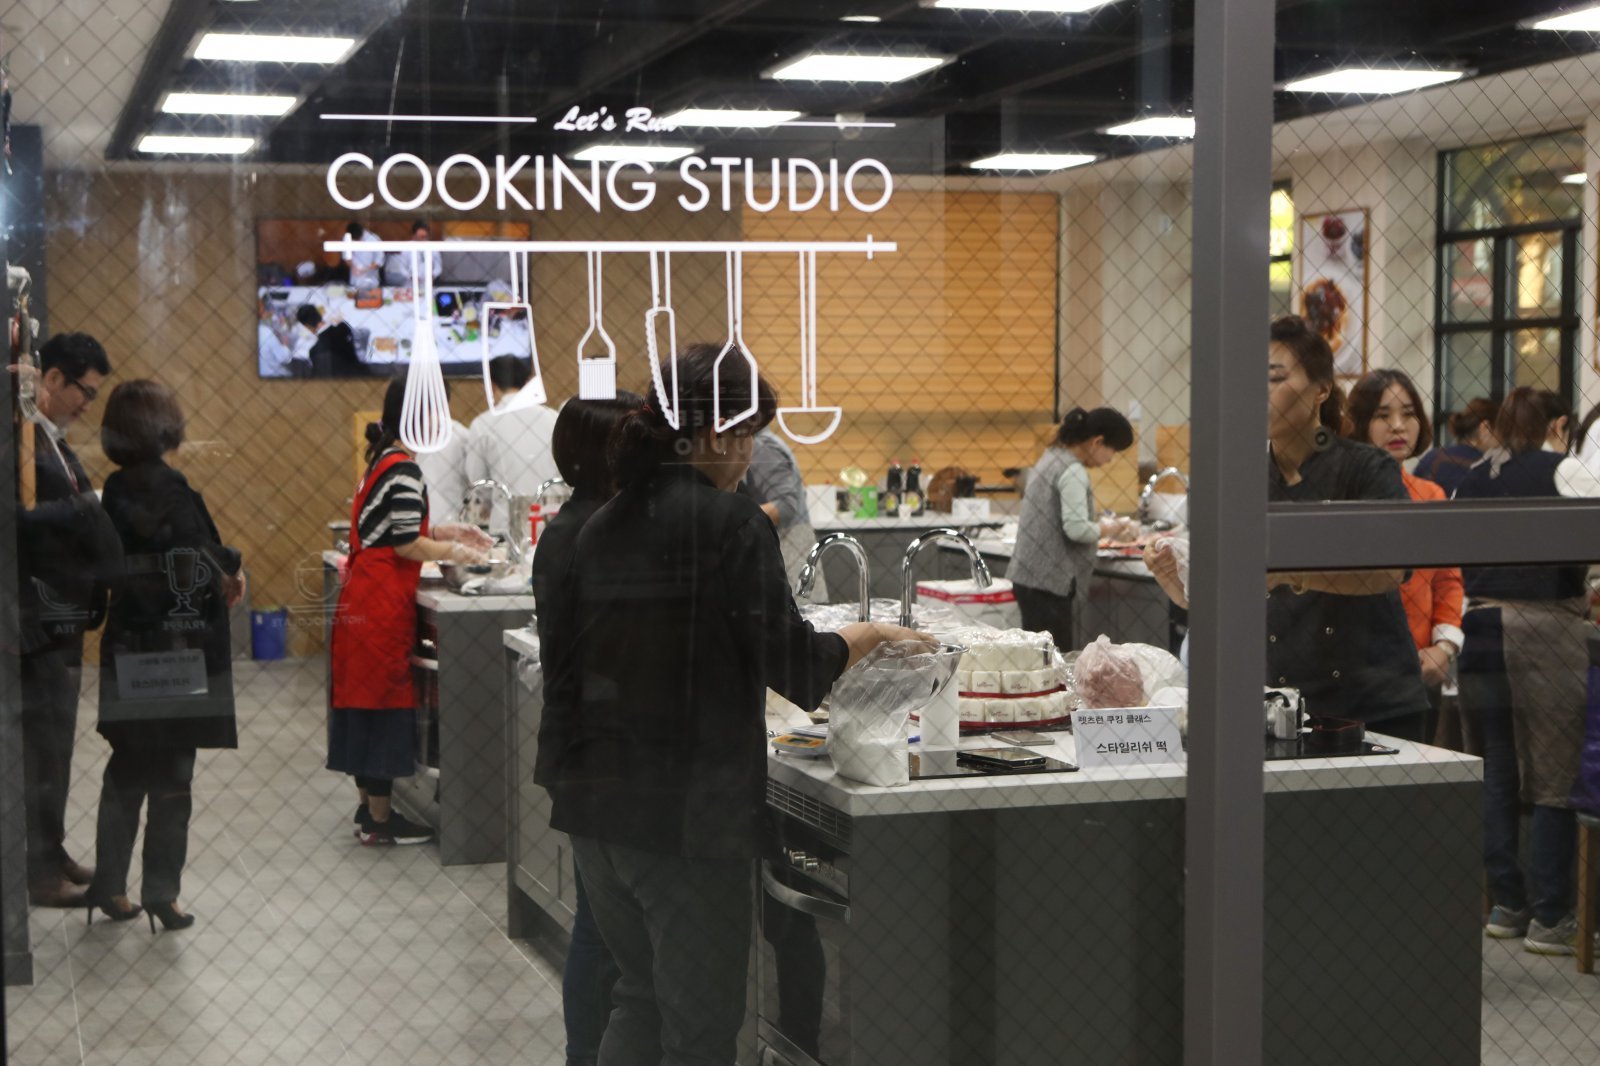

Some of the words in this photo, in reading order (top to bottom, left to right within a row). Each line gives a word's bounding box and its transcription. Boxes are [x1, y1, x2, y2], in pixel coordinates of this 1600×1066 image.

[553, 104, 618, 132] Let's
[624, 106, 678, 133] Run
[326, 152, 657, 212] COOKING
[677, 157, 894, 213] STUDIO
[1078, 715, 1105, 725] 렛츠런
[1106, 714, 1124, 724] 쿠킹
[1126, 714, 1152, 724] 클래스
[1096, 741, 1153, 754] 스타일리쉬
[1156, 740, 1168, 752] 떡
